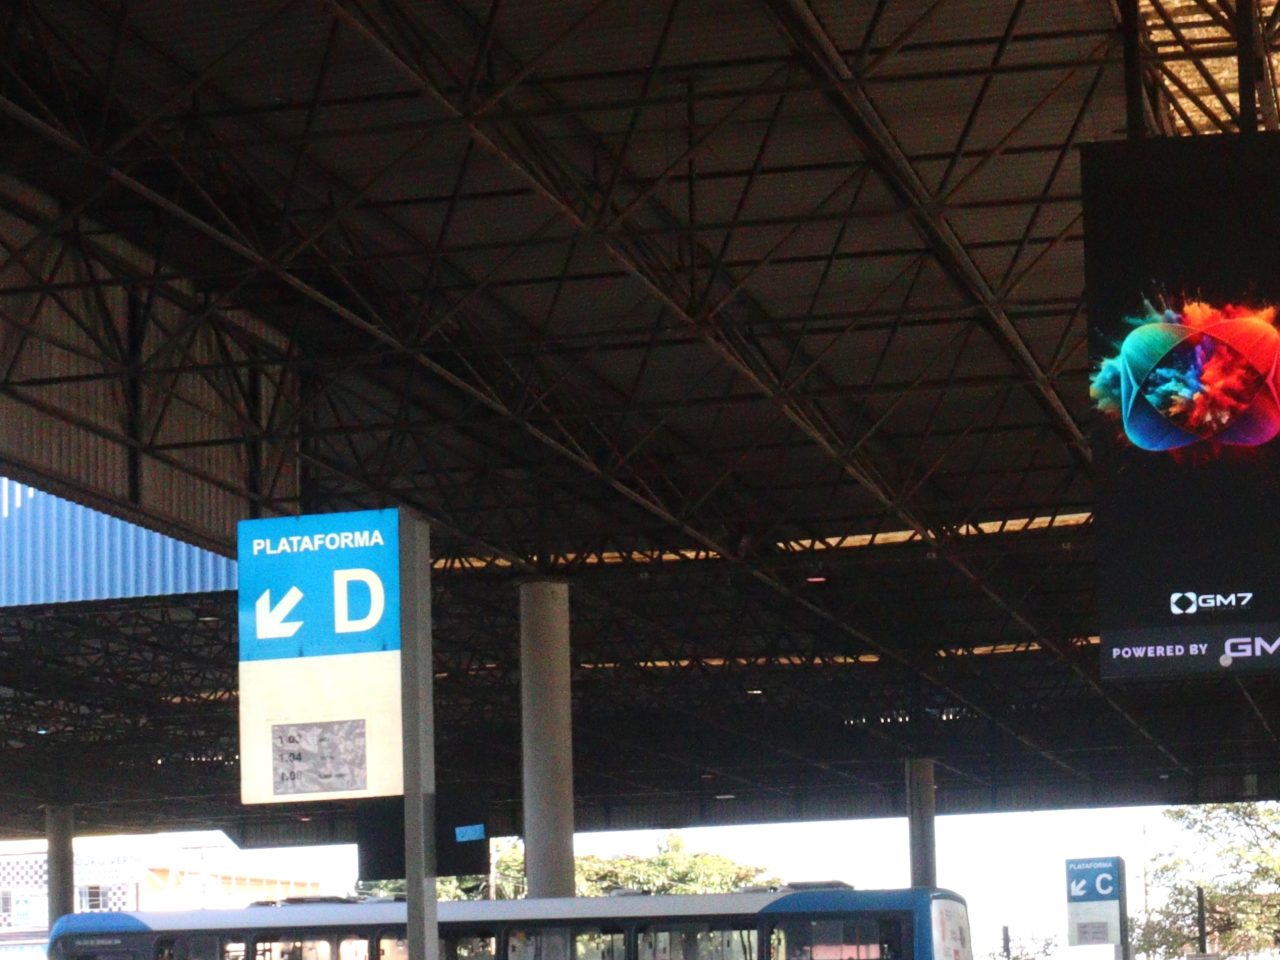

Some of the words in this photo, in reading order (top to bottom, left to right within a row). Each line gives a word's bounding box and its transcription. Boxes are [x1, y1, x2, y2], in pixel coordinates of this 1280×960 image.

[252, 529, 385, 556] PLATAFORMA
[333, 567, 385, 634] D
[1198, 592, 1253, 608] GM7
[1112, 644, 1185, 659] POWERED
[1189, 643, 1208, 656] BY
[1069, 861, 1113, 870] PLATAFORMA
[1095, 872, 1113, 895] C
